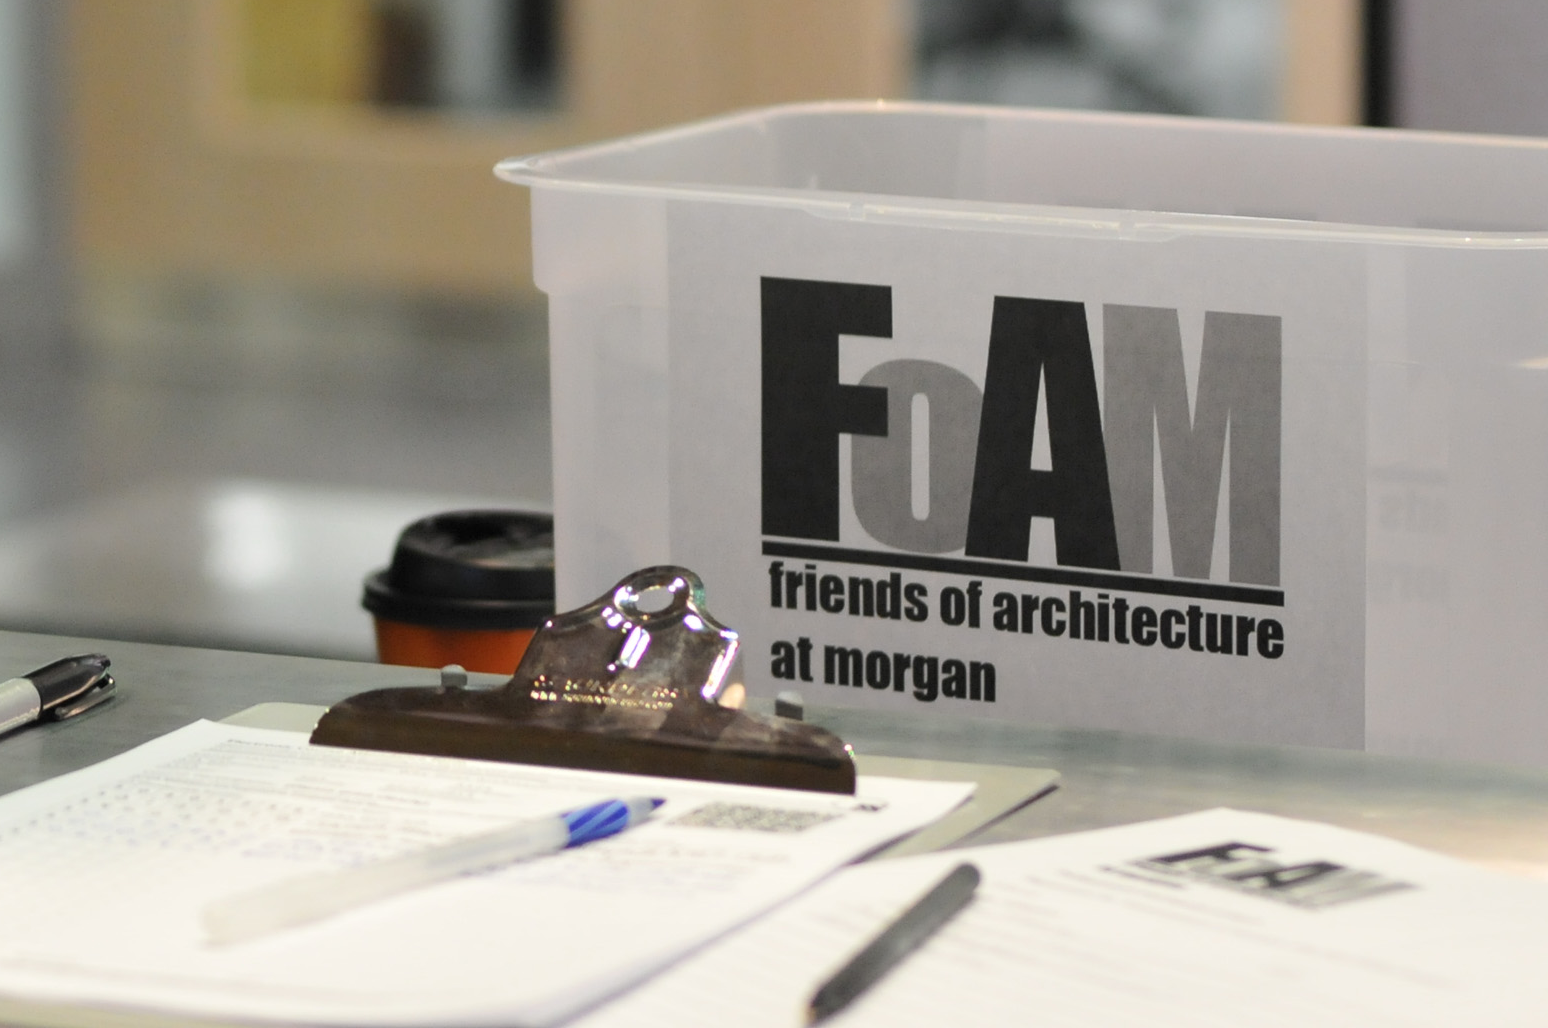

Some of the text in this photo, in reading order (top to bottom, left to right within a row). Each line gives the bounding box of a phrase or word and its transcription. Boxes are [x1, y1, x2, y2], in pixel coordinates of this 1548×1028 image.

[760, 275, 1282, 587] FoAM
[768, 561, 1284, 660] friends of architecture
[770, 636, 996, 703] at morgan
